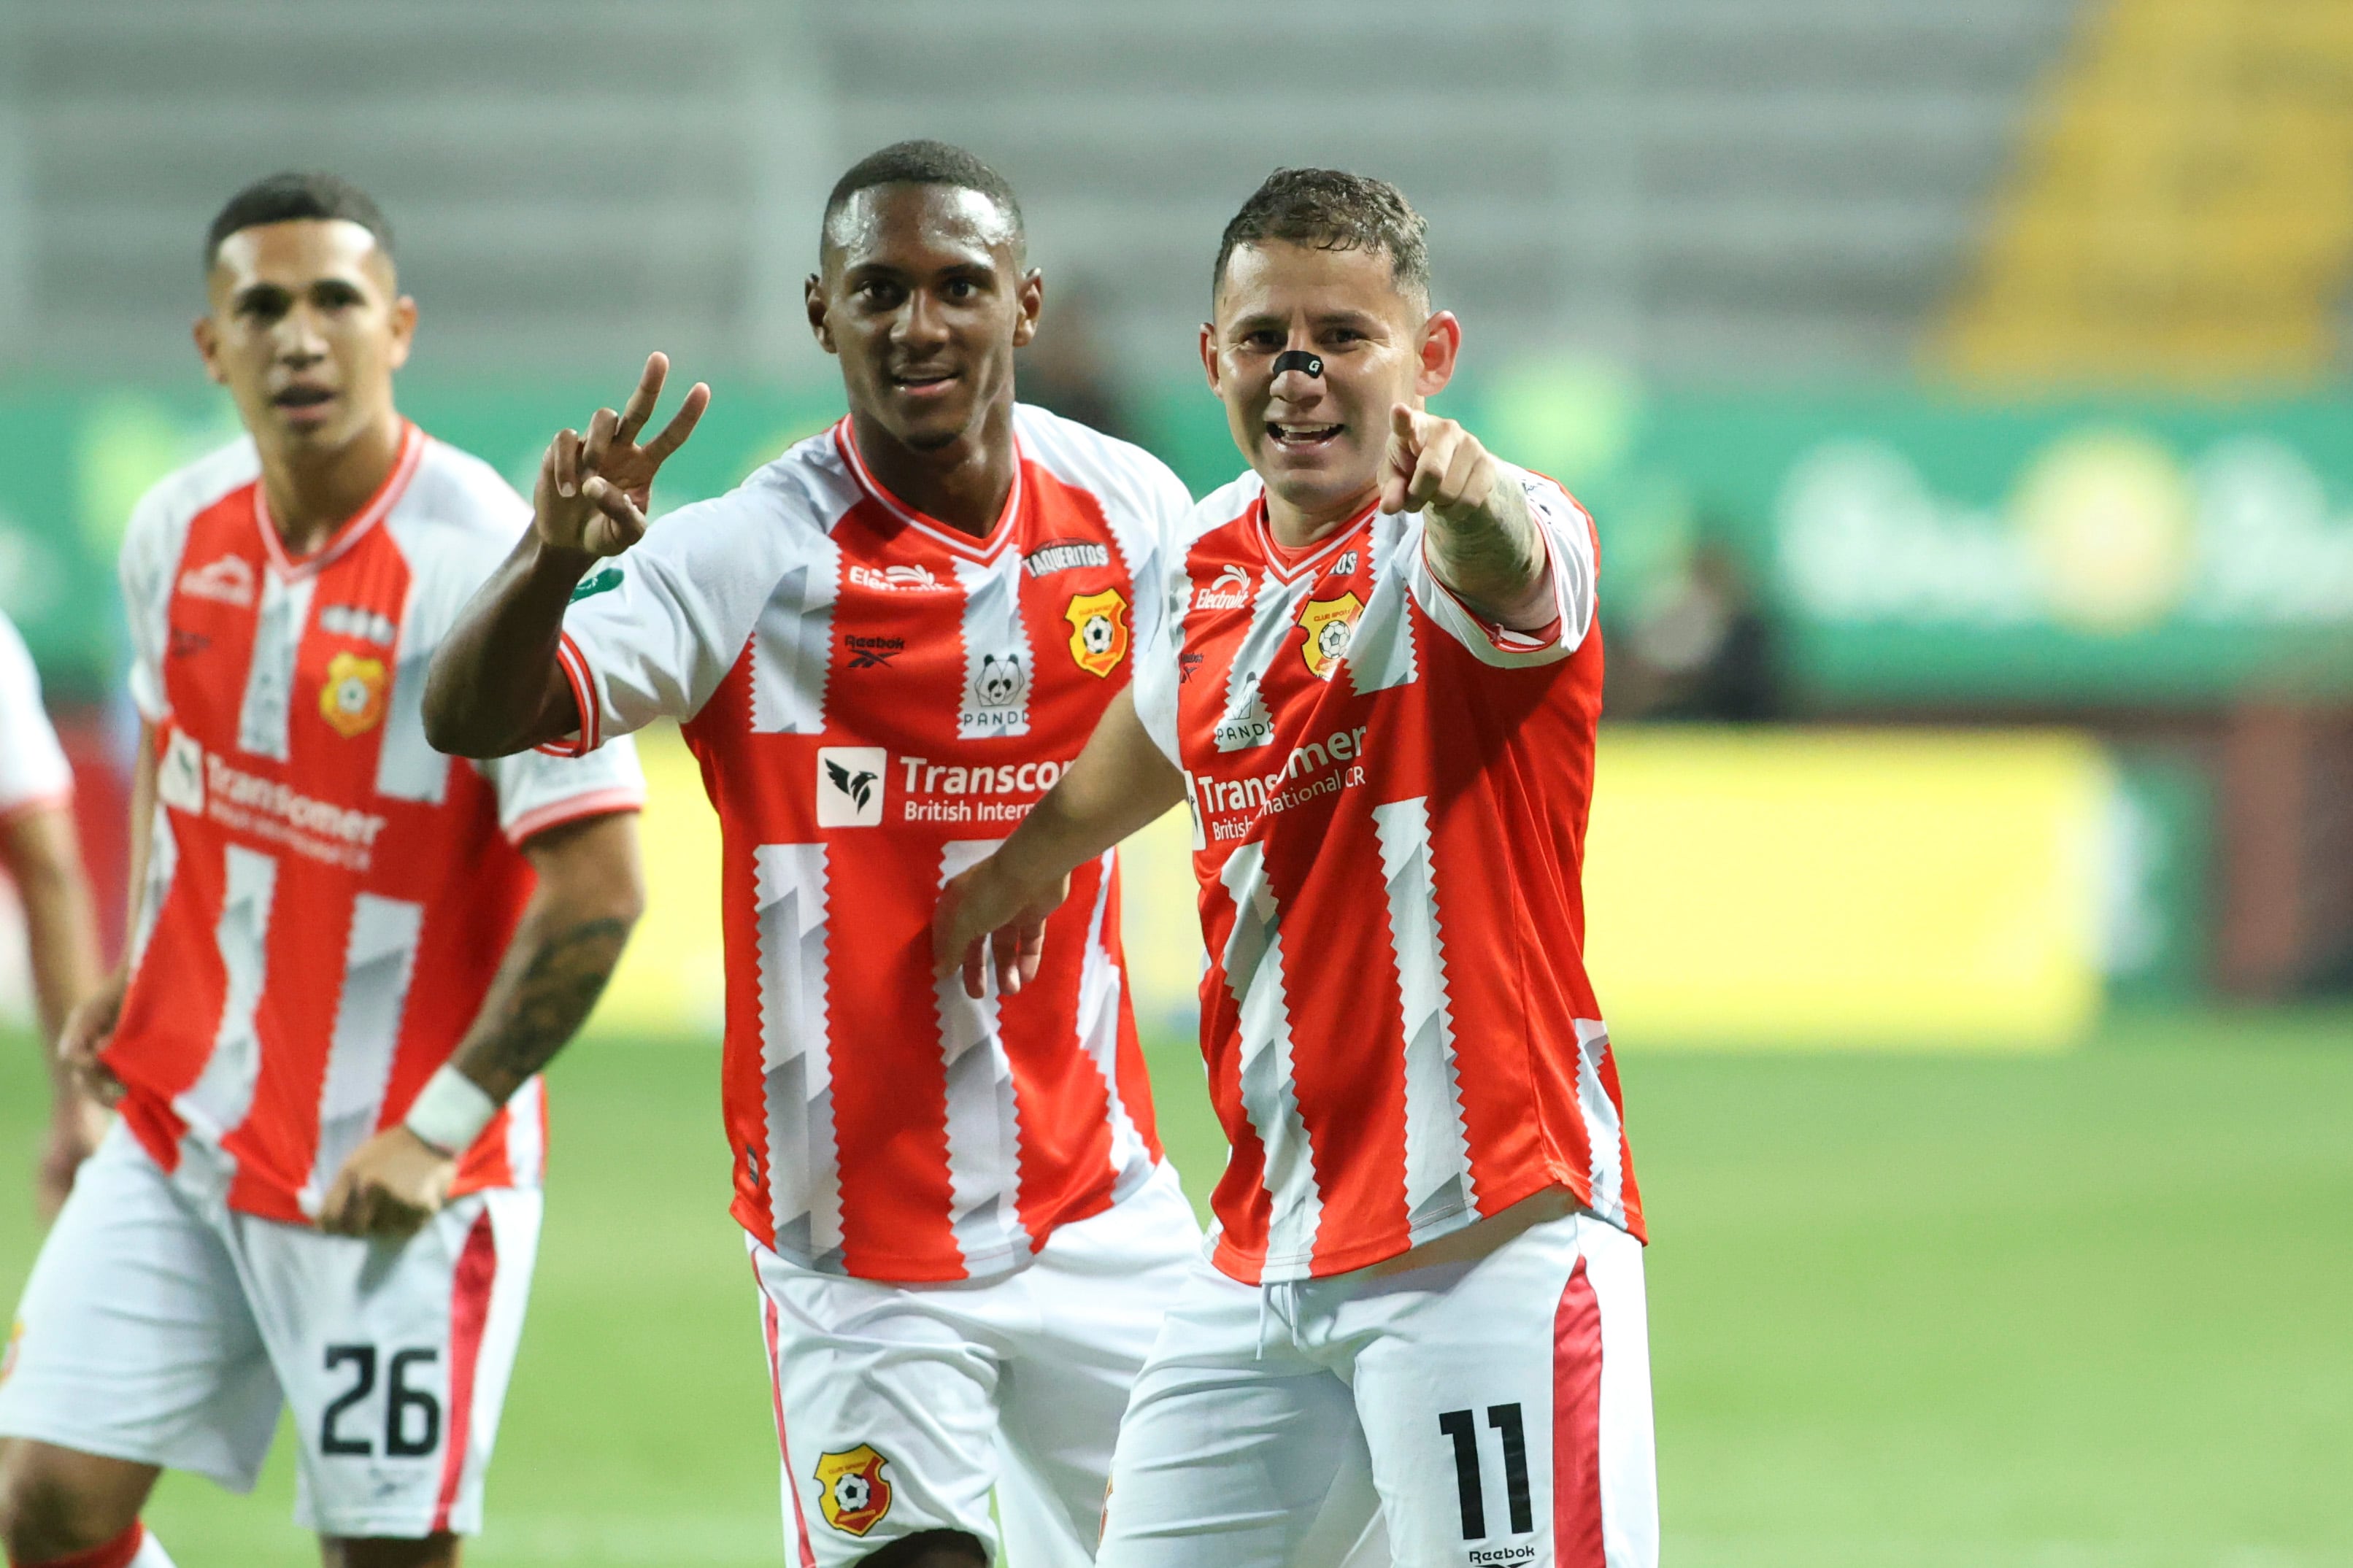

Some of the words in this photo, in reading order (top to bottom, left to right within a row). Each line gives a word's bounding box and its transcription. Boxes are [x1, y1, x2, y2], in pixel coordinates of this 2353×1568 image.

[1021, 544, 1109, 579] TAQUERITOS
[844, 635, 906, 649] Reebok
[963, 710, 1025, 726] PAND
[1217, 721, 1272, 741] PAND
[905, 800, 971, 822] British
[1212, 814, 1254, 841] British
[1345, 766, 1366, 787] CR
[321, 1343, 441, 1456] 26
[1439, 1402, 1533, 1540] 11
[1469, 1545, 1535, 1564] Reebok
